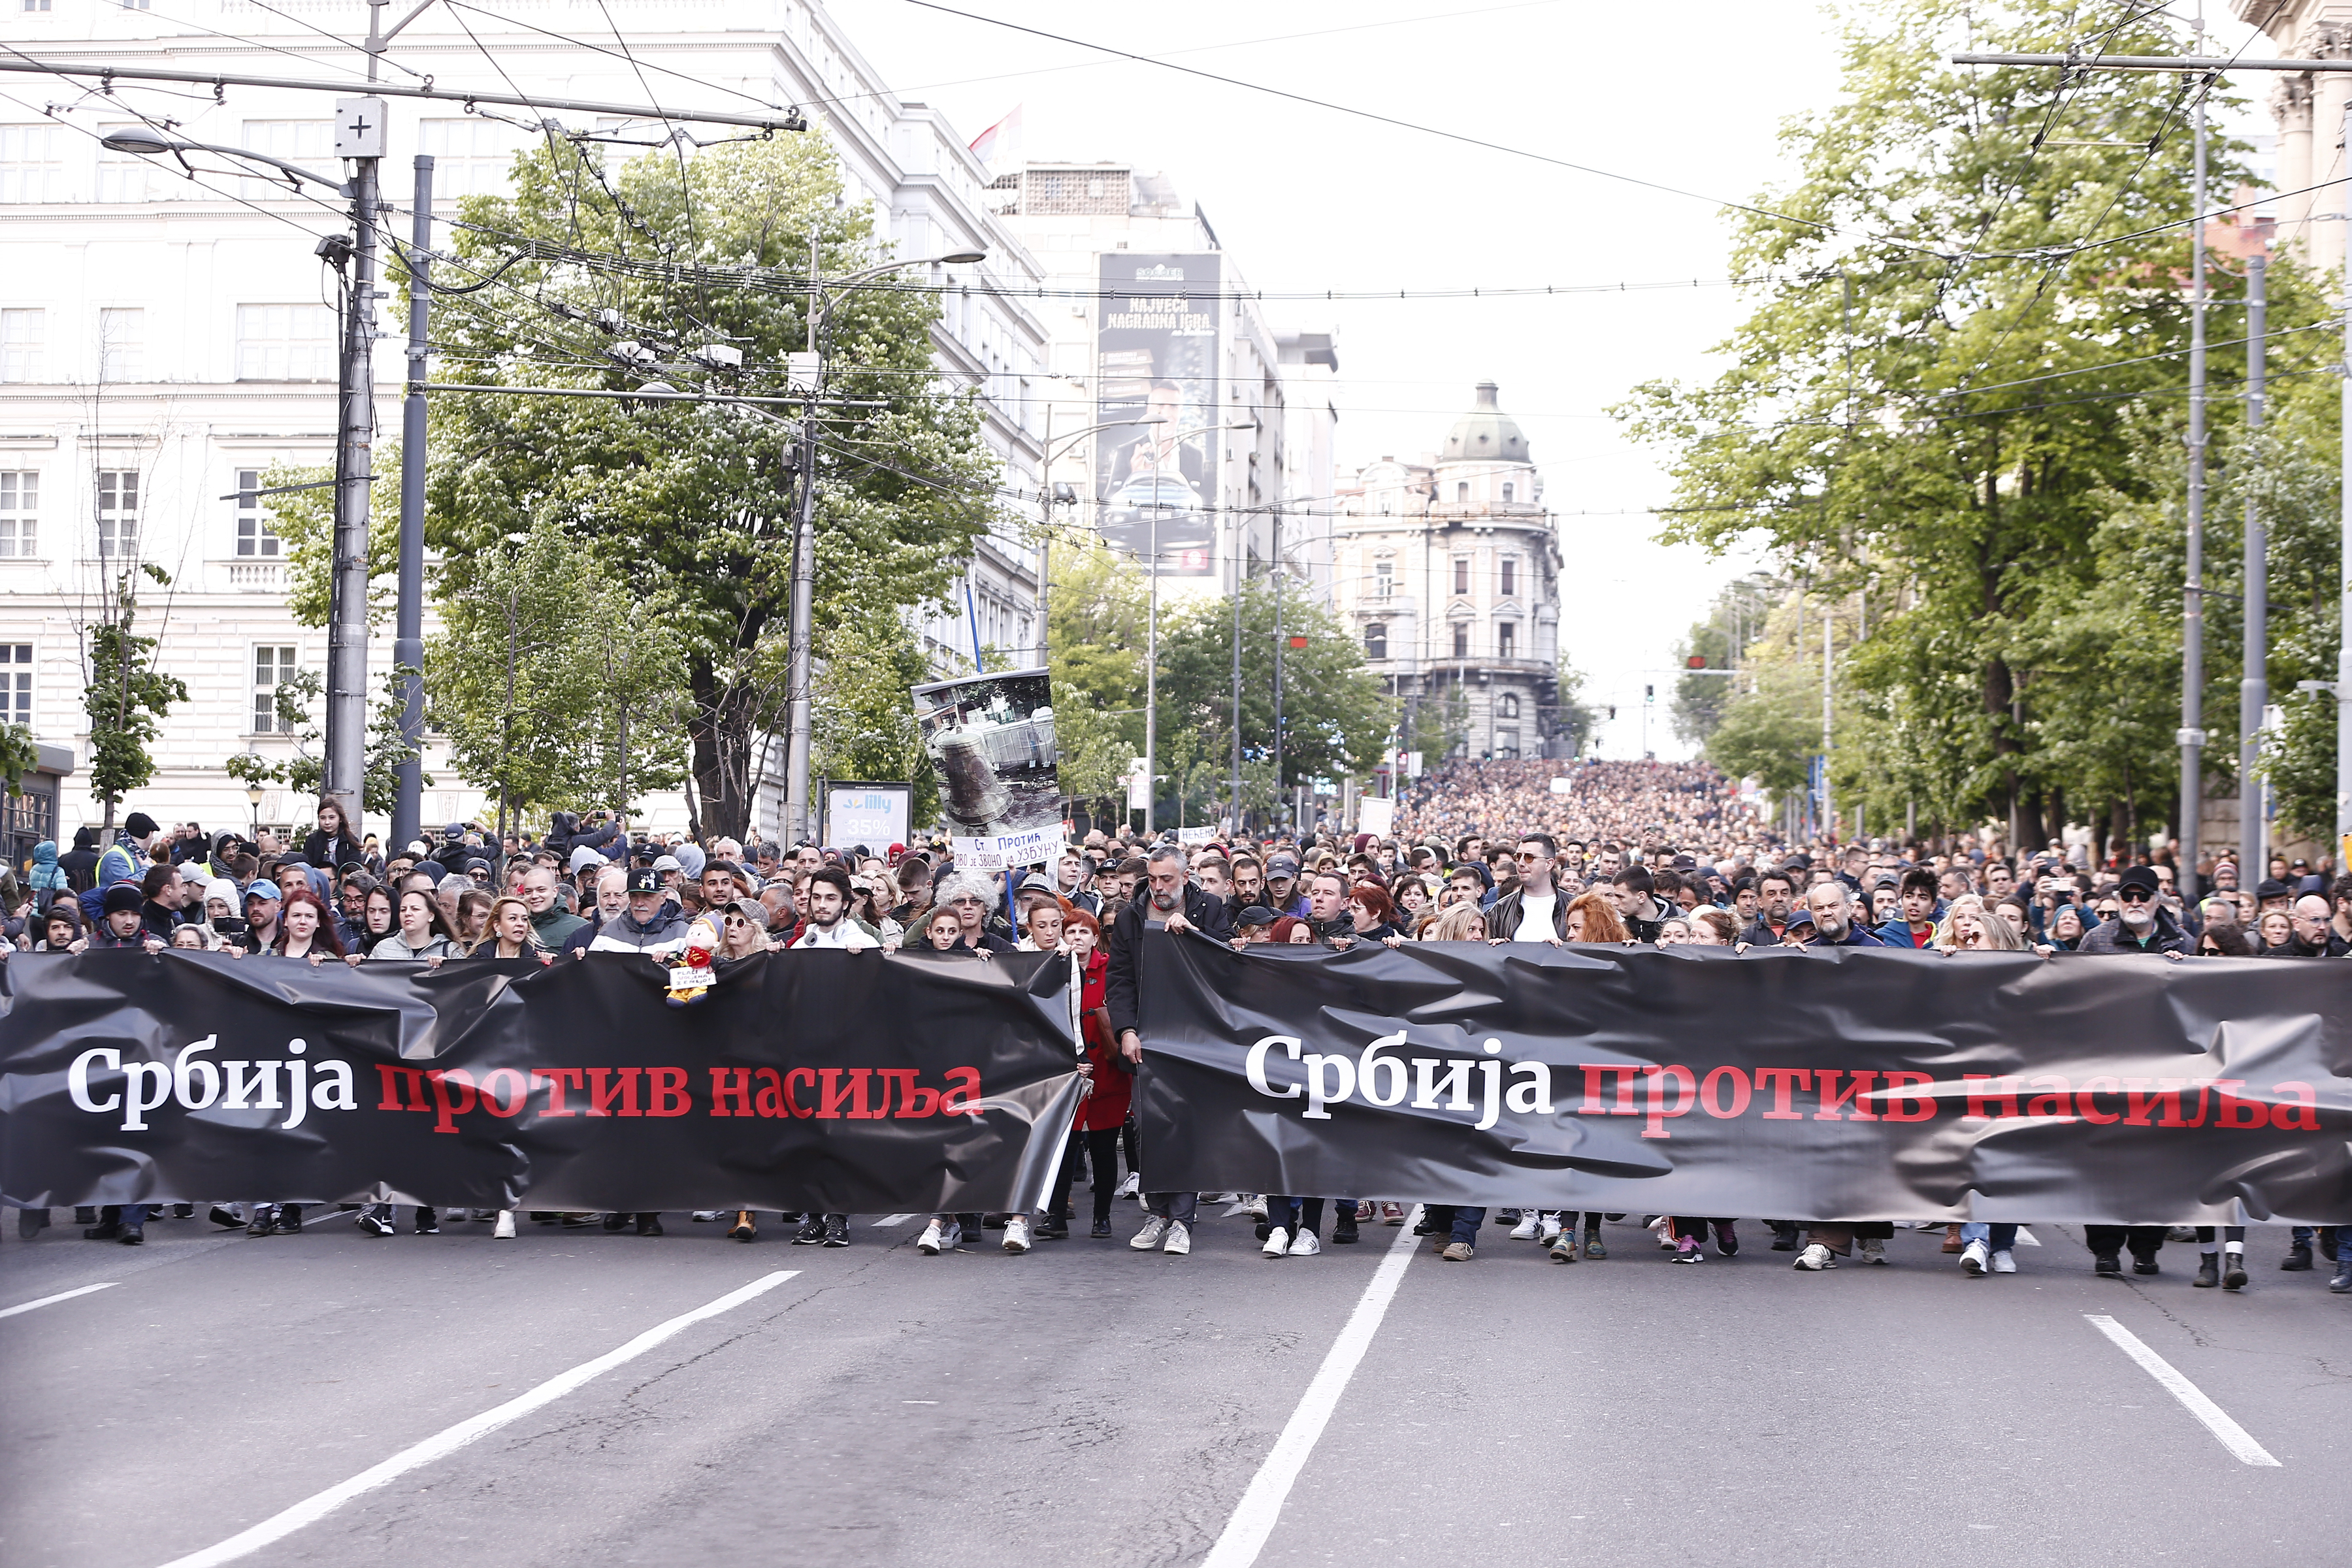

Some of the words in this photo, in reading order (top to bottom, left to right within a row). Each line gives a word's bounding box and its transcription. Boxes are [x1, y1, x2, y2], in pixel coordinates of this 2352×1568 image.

[1108, 313, 1177, 329] NAGRADNA
[1179, 313, 1210, 329] IGRA
[865, 794, 892, 813] lilly
[847, 819, 890, 836] 35%
[979, 854, 1002, 867] ЗВОНО
[68, 1034, 358, 1132] Србија
[375, 1063, 693, 1134] против
[710, 1066, 985, 1120] насиља
[1244, 1030, 1555, 1131] Србија
[1577, 1063, 1938, 1138] против
[1962, 1073, 2321, 1131] насиља
